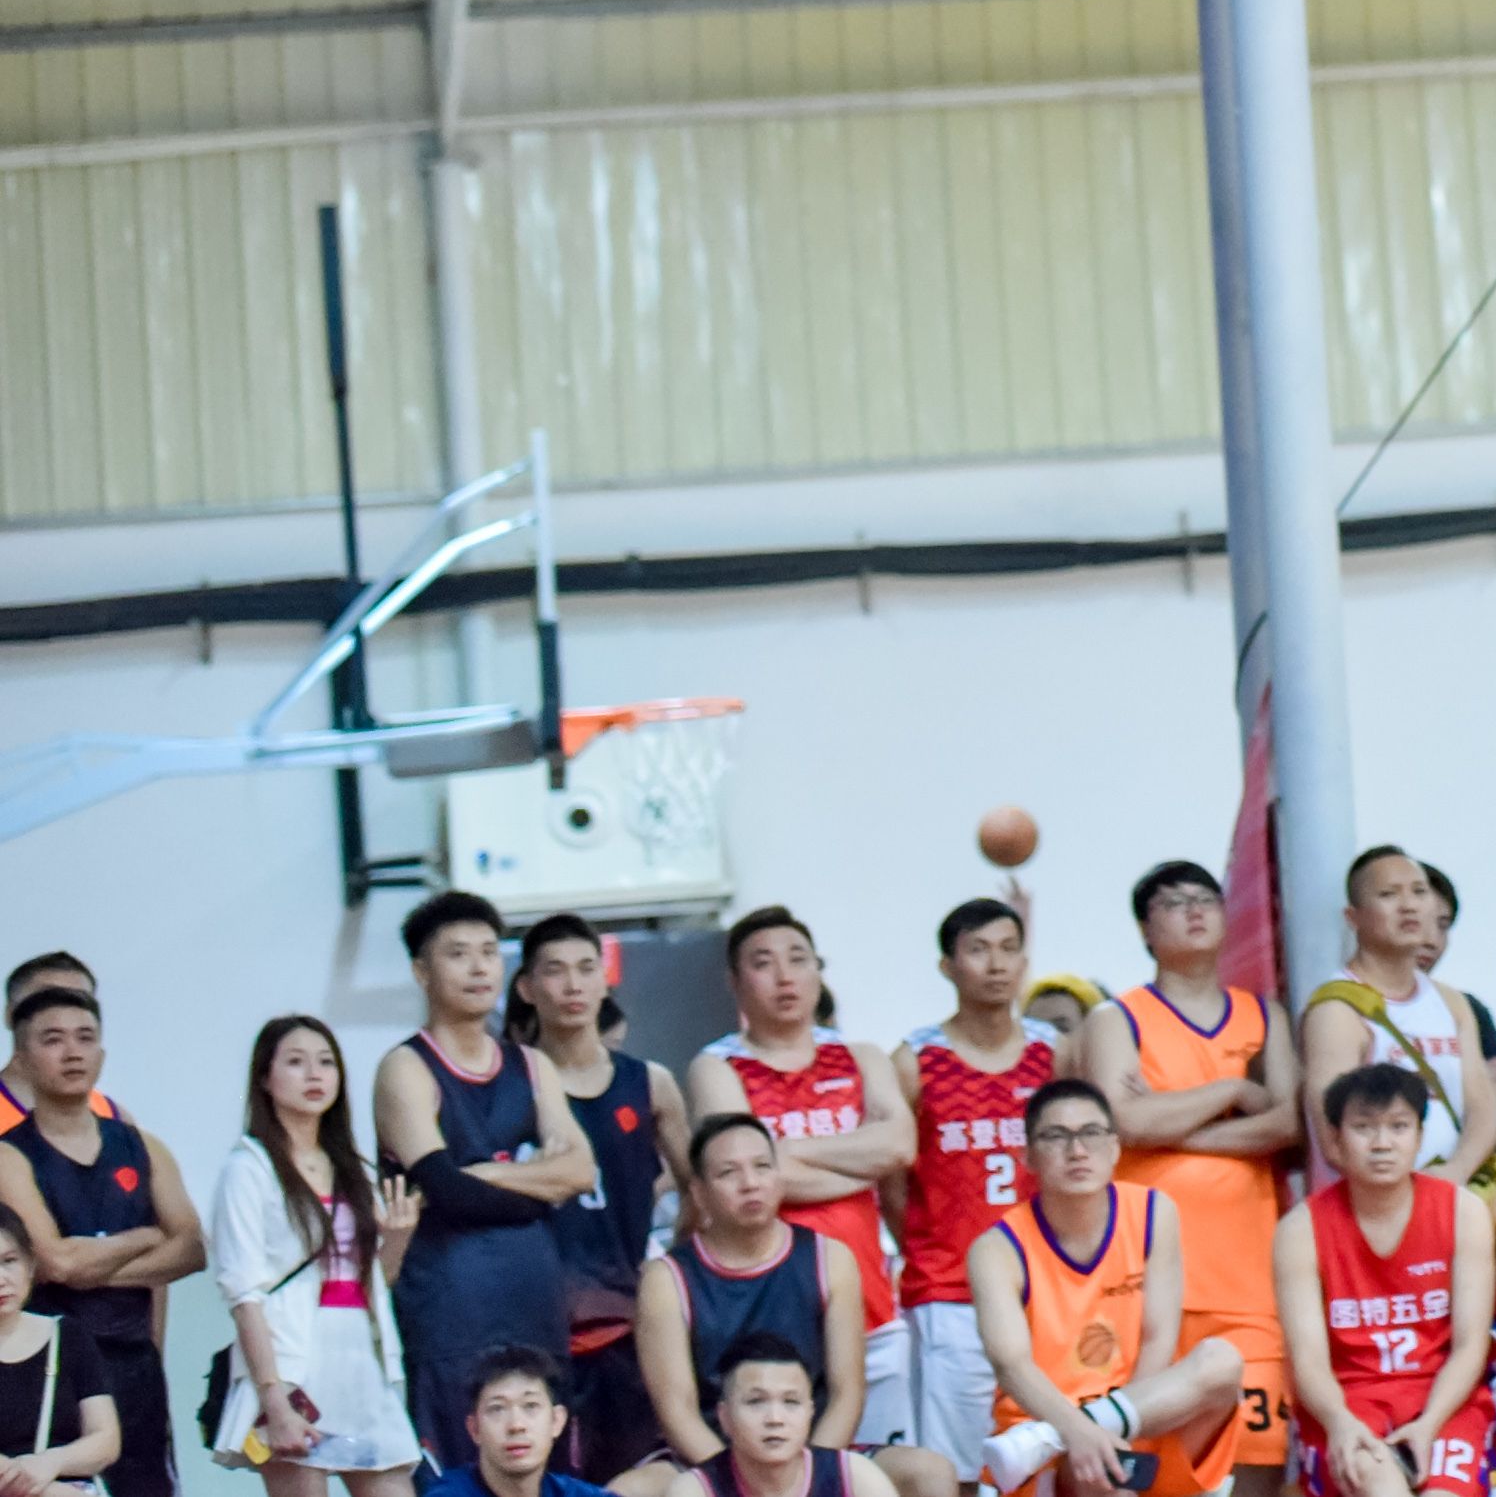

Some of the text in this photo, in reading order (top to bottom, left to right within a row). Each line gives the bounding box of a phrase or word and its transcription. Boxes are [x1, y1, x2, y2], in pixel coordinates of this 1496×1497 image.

[985, 1154, 1018, 1206] 2
[1369, 1328, 1421, 1373] 12
[1429, 1437, 1475, 1483] 12
